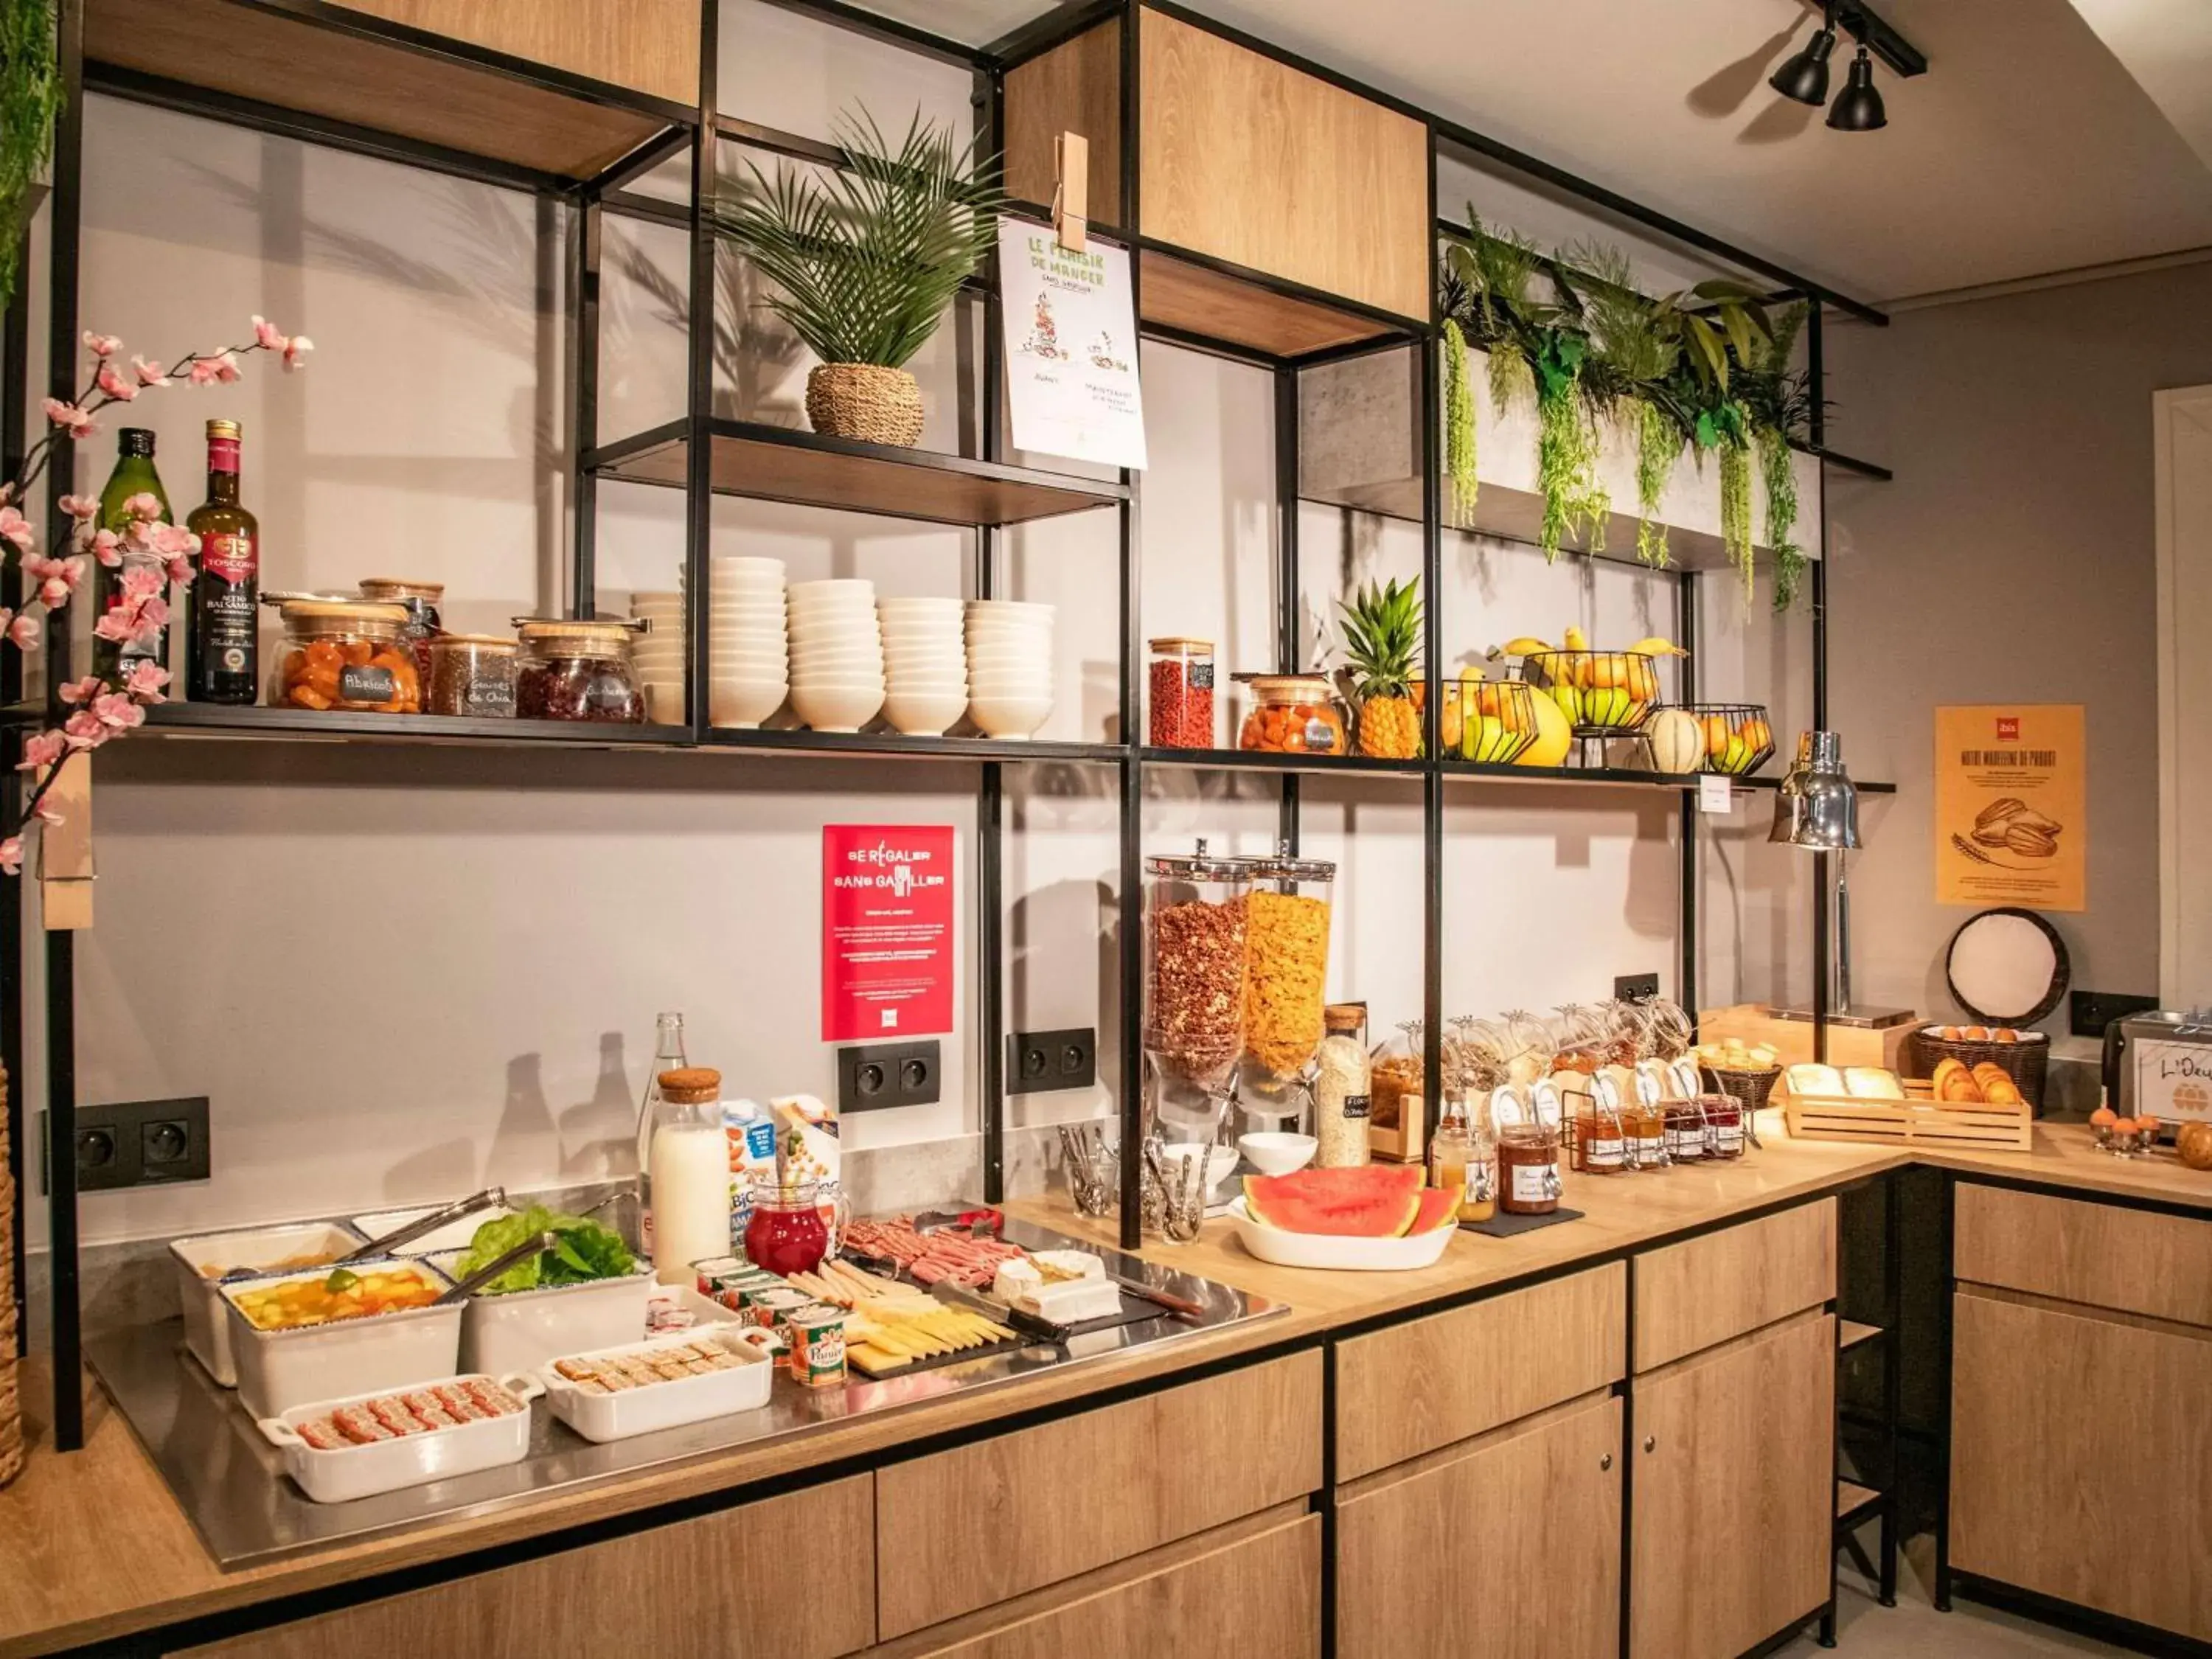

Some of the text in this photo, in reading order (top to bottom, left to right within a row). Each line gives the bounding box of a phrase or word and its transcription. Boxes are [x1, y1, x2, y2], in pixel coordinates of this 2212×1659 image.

[1028, 237, 1043, 253] LE
[1031, 255, 1046, 271] DE
[2161, 1057, 2212, 1080] L'Oeu
